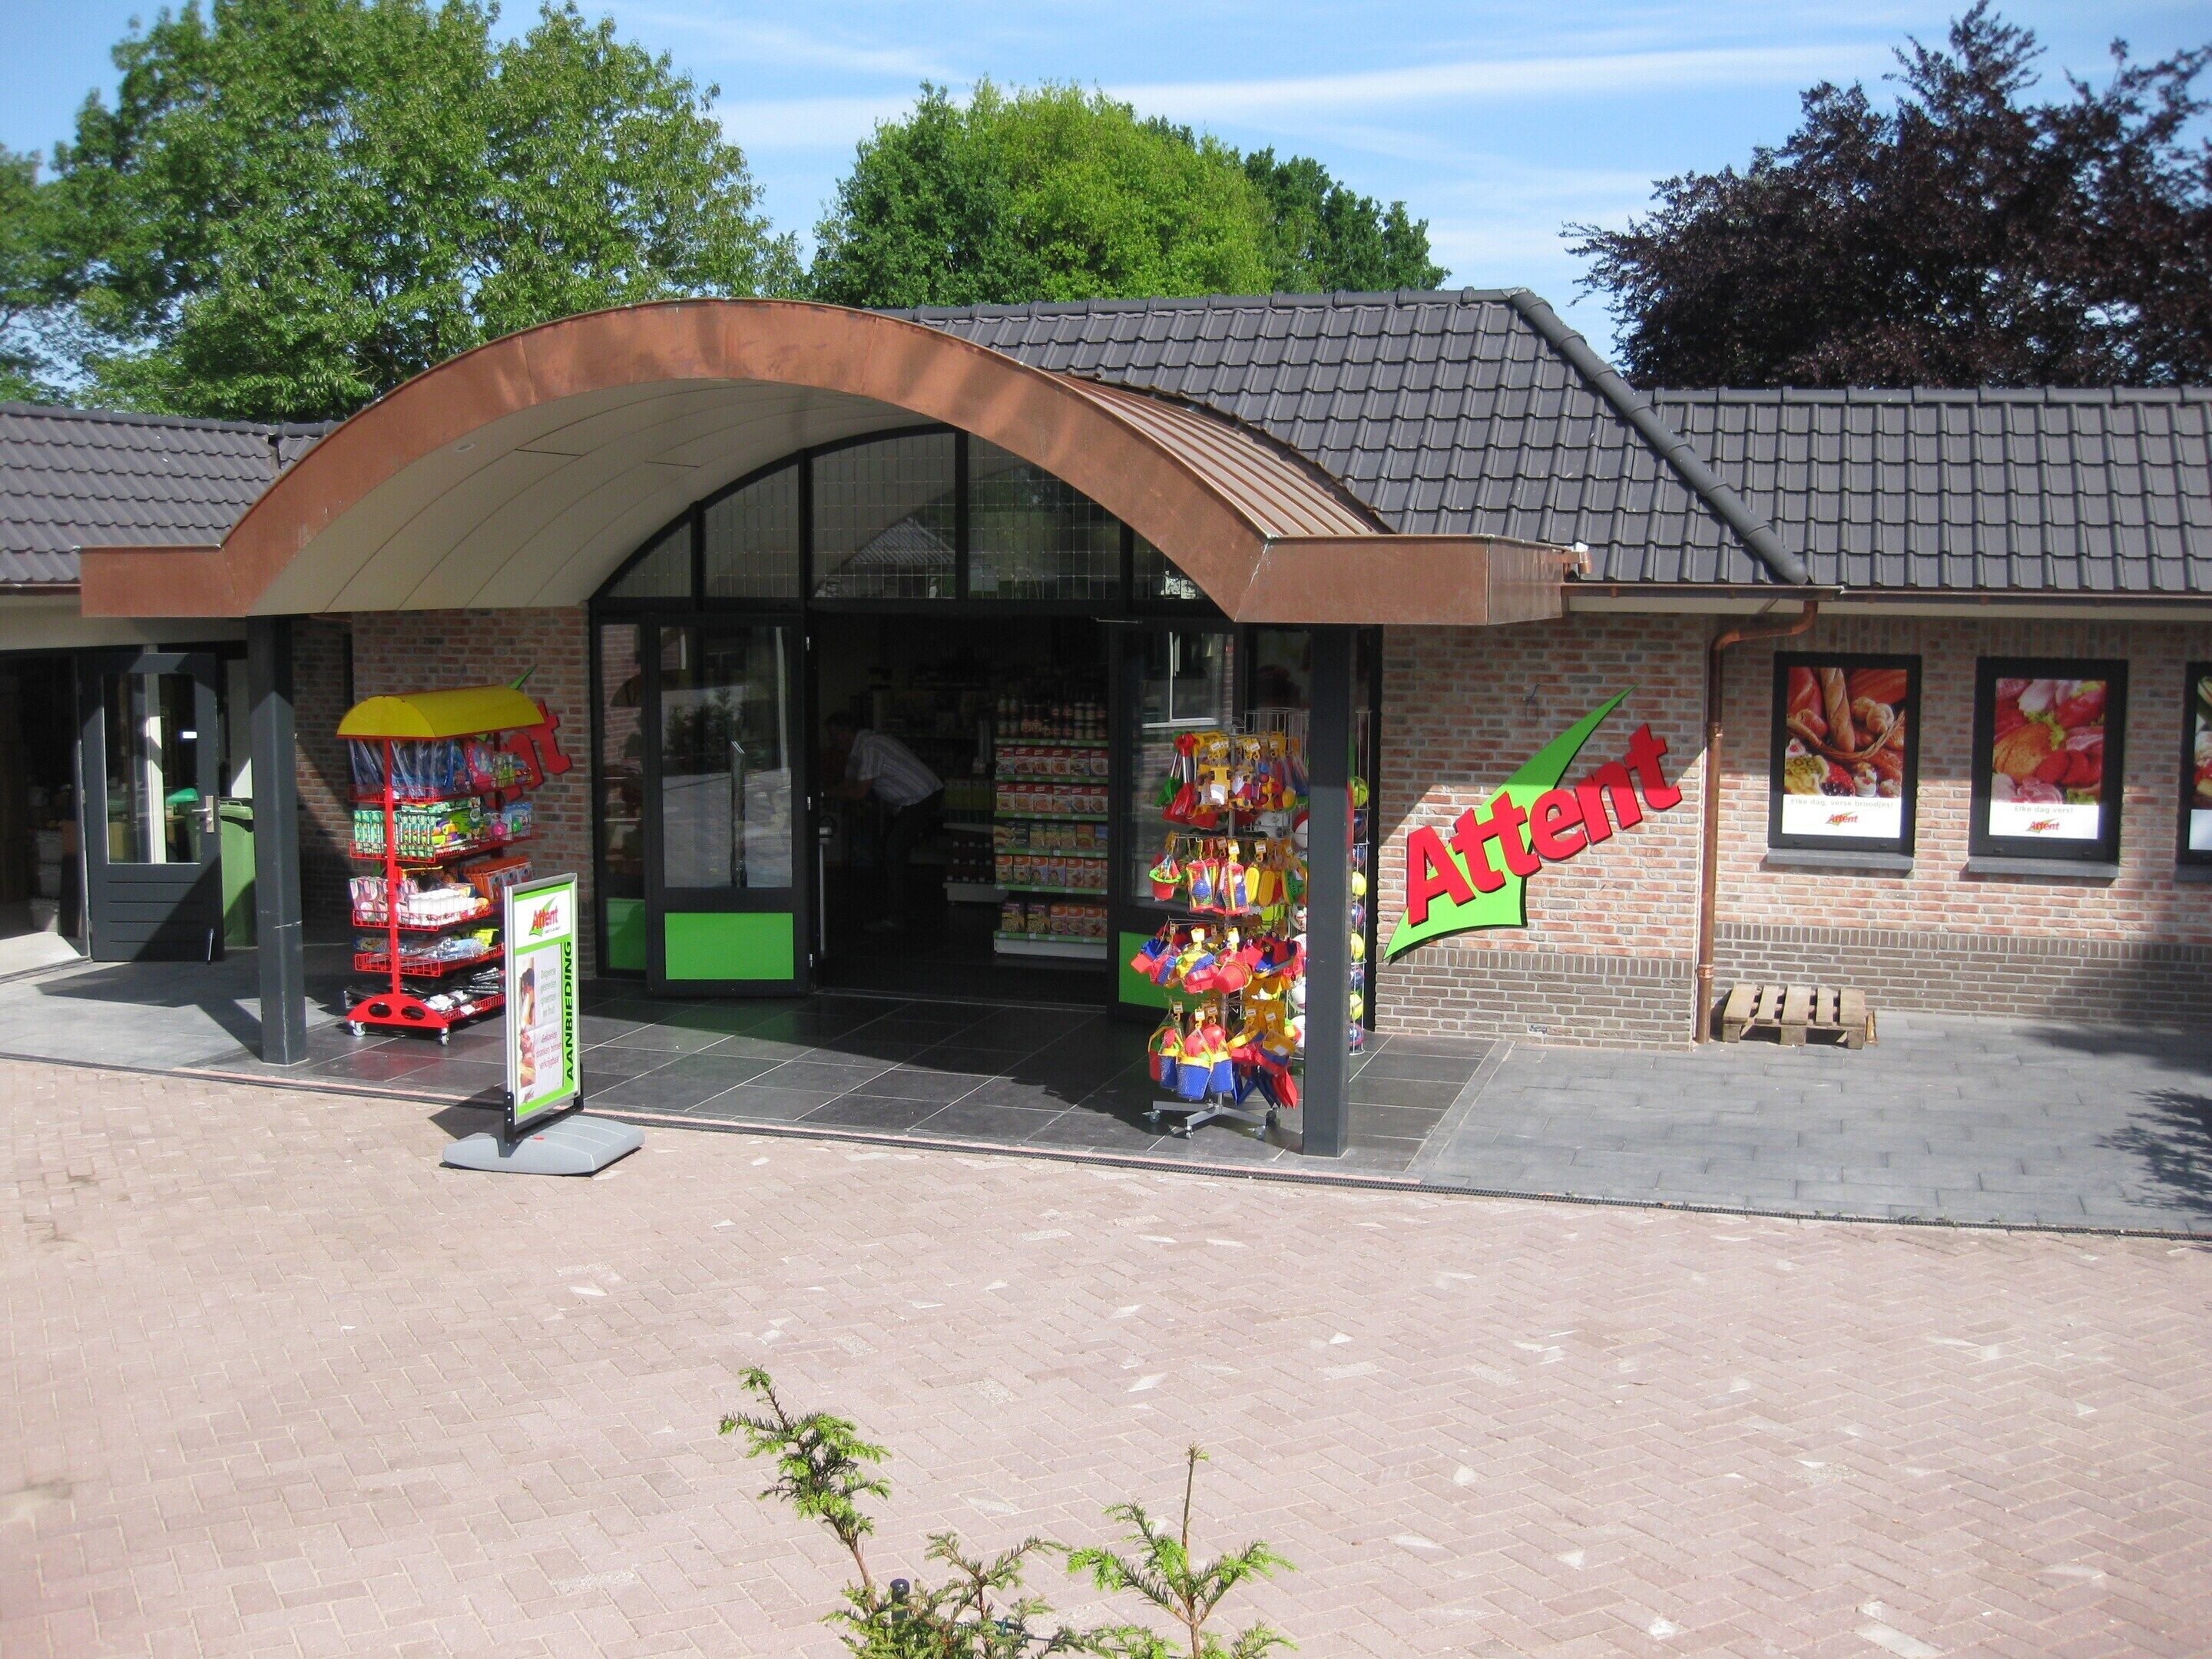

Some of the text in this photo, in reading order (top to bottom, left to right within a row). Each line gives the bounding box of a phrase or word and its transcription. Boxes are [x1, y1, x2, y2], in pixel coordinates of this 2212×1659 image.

[1407, 724, 1682, 926] Attent
[1829, 813, 1859, 823] Attent
[2030, 820, 2060, 831] Attent
[531, 906, 558, 931] Attent
[564, 941, 574, 1081] AANBIEDING
